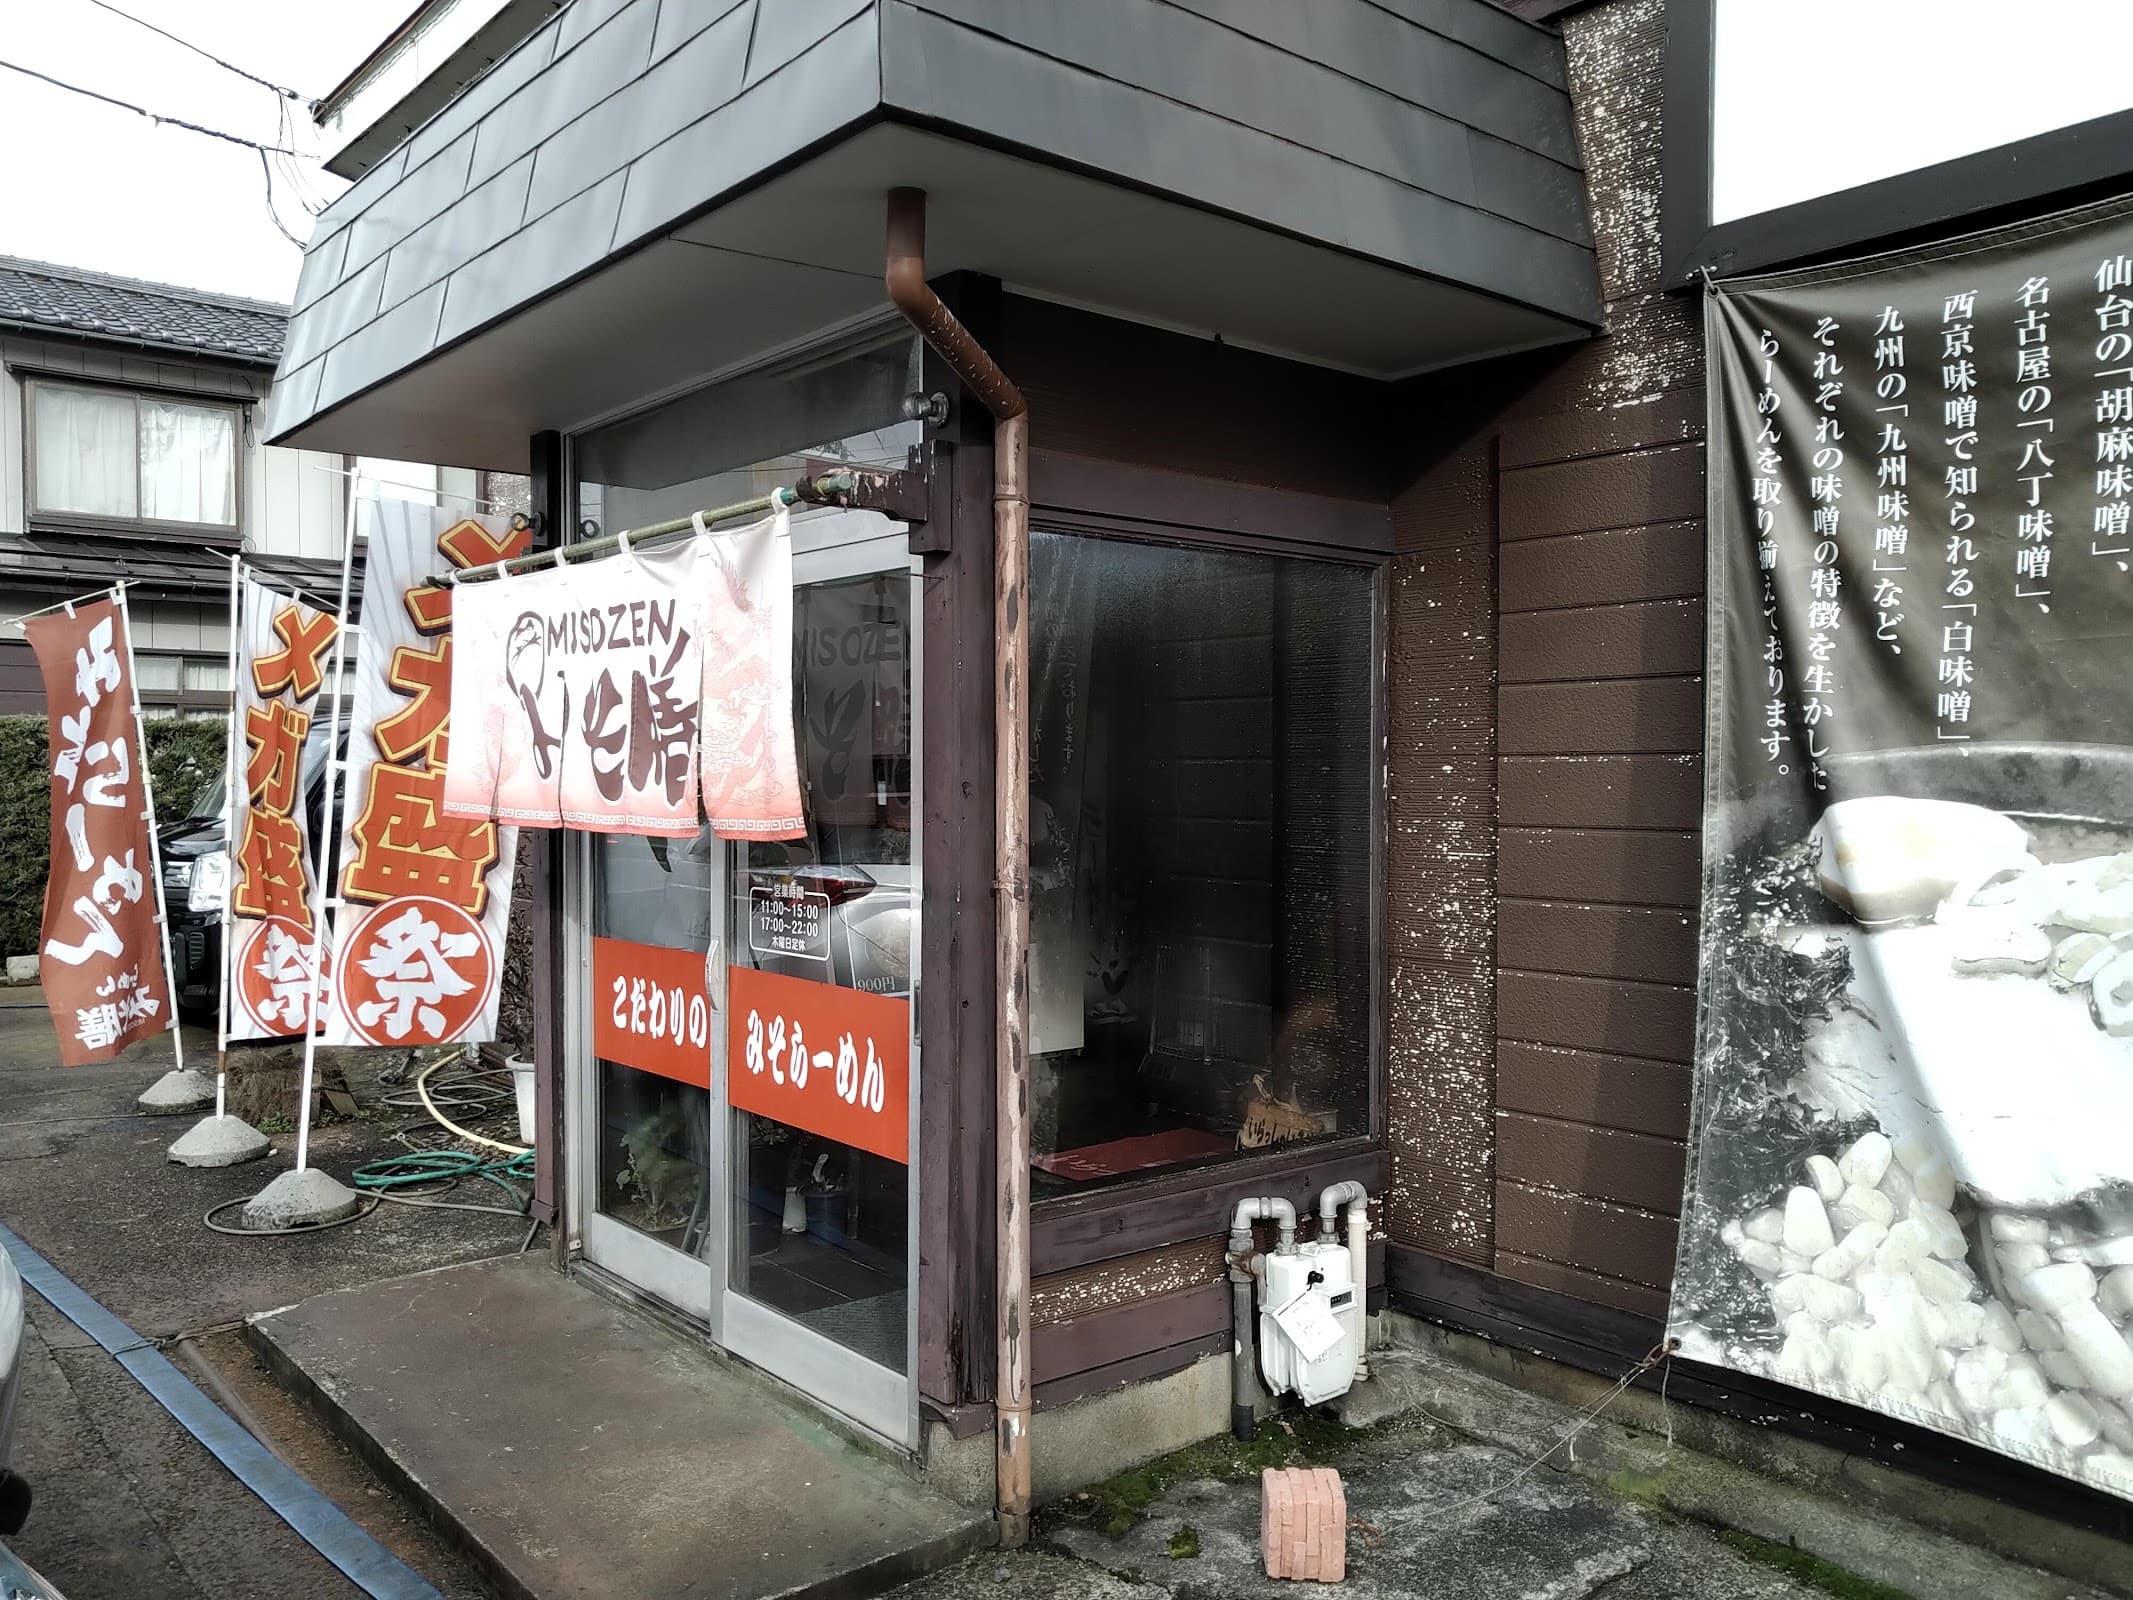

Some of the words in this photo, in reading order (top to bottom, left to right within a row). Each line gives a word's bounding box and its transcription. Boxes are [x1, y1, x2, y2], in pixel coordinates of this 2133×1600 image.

[1872, 304, 1910, 656] 九州の「九州味噌」など、
[2014, 276, 2056, 614] 名古屋の「八丁味噌」、
[1802, 316, 1845, 791] それぞれの味噌の特徴を生かした
[1937, 289, 1979, 758] 西京味噌で知られる「白味噌」、
[761, 900, 819, 919] 11:00~15:00
[761, 917, 819, 937] 17:00~22:00
[771, 935, 806, 951] 木曜日定休
[773, 882, 805, 900] 営業時間
[357, 907, 483, 1039] 祭
[613, 975, 708, 1049] こだわりの
[745, 1009, 885, 1113] みそらーめん
